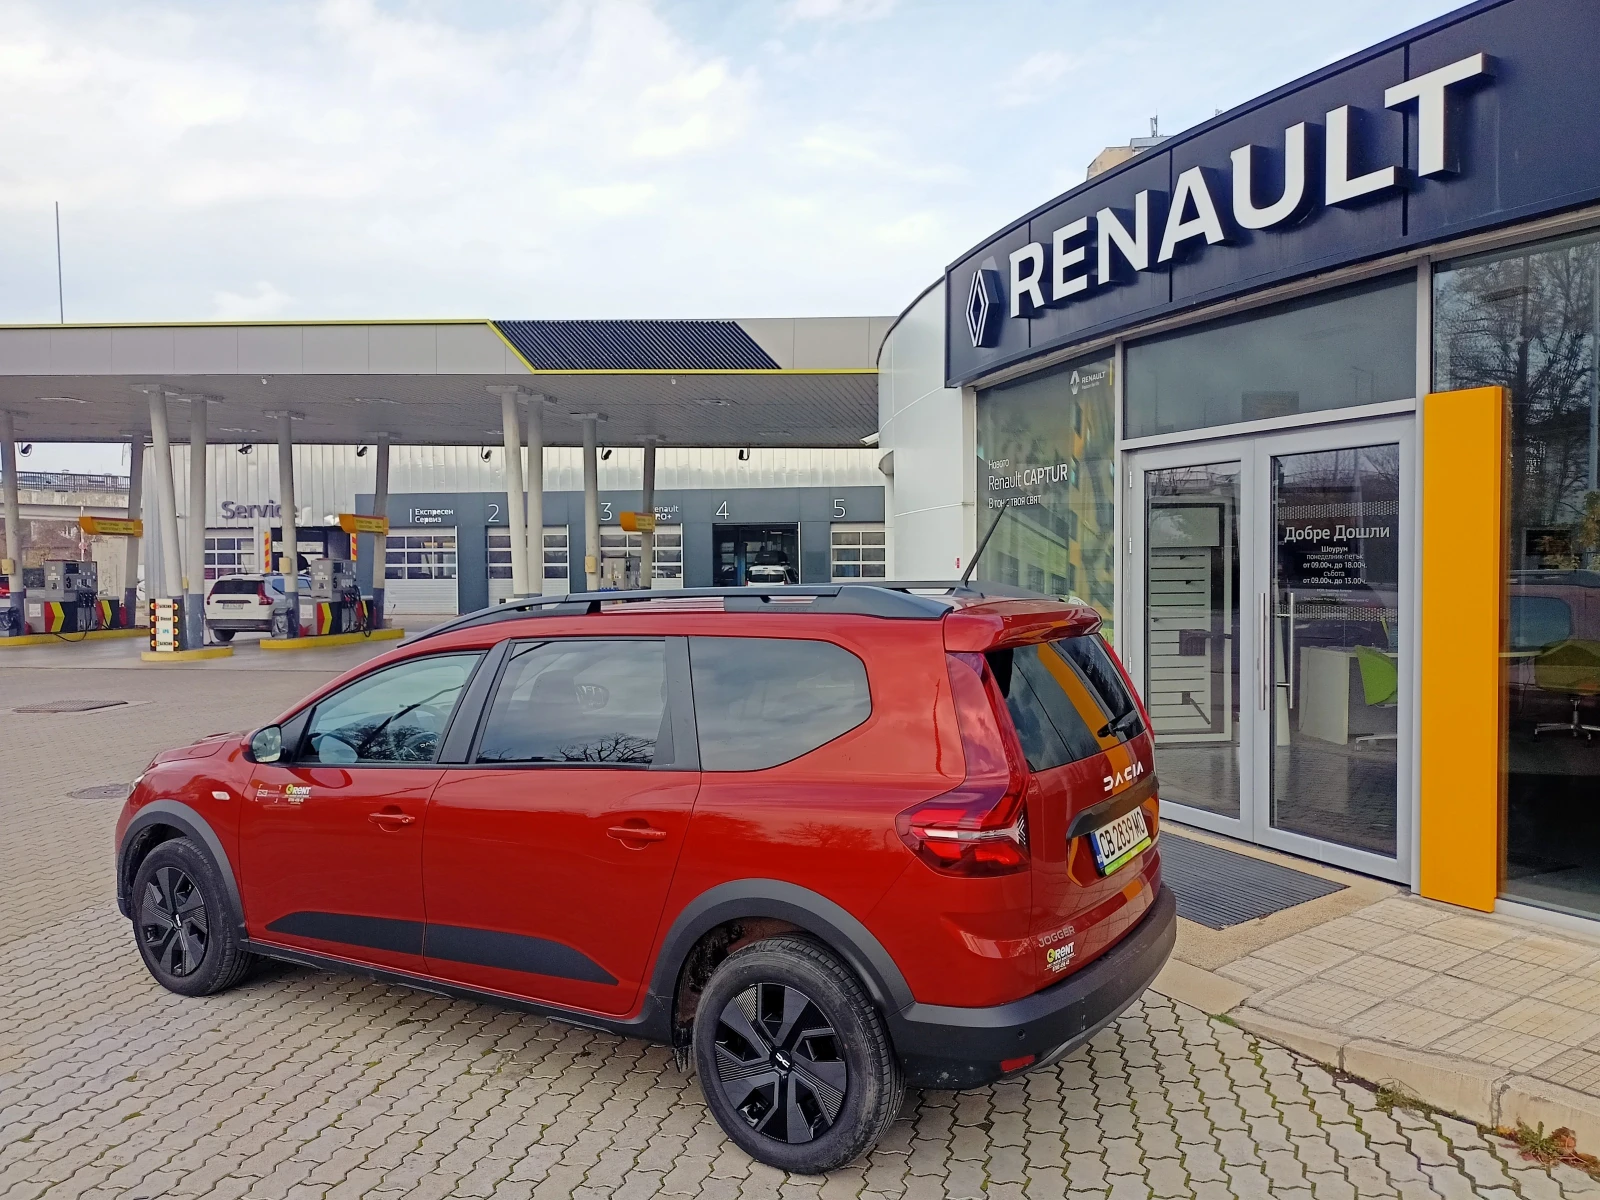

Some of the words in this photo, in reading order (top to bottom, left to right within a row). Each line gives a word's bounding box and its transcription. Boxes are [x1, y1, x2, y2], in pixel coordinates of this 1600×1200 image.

[1009, 52, 1487, 318] RENAULT
[1081, 371, 1105, 383] RENAULT
[988, 471, 1021, 491] Renault
[1023, 464, 1068, 486] CAPTUR
[221, 500, 299, 519] Servic
[415, 508, 454, 516] Експресен
[488, 504, 499, 522] 2
[600, 502, 613, 521] 3
[715, 501, 730, 519] 4
[833, 499, 847, 518] 5
[415, 516, 442, 524] Сервиз
[1284, 526, 1330, 543] Добре
[1333, 525, 1390, 541] Дошли
[1103, 761, 1144, 792] DACIA
[1099, 829, 1115, 859] CB
[1112, 817, 1135, 851] 2839
[1038, 925, 1075, 948] JOGGER
